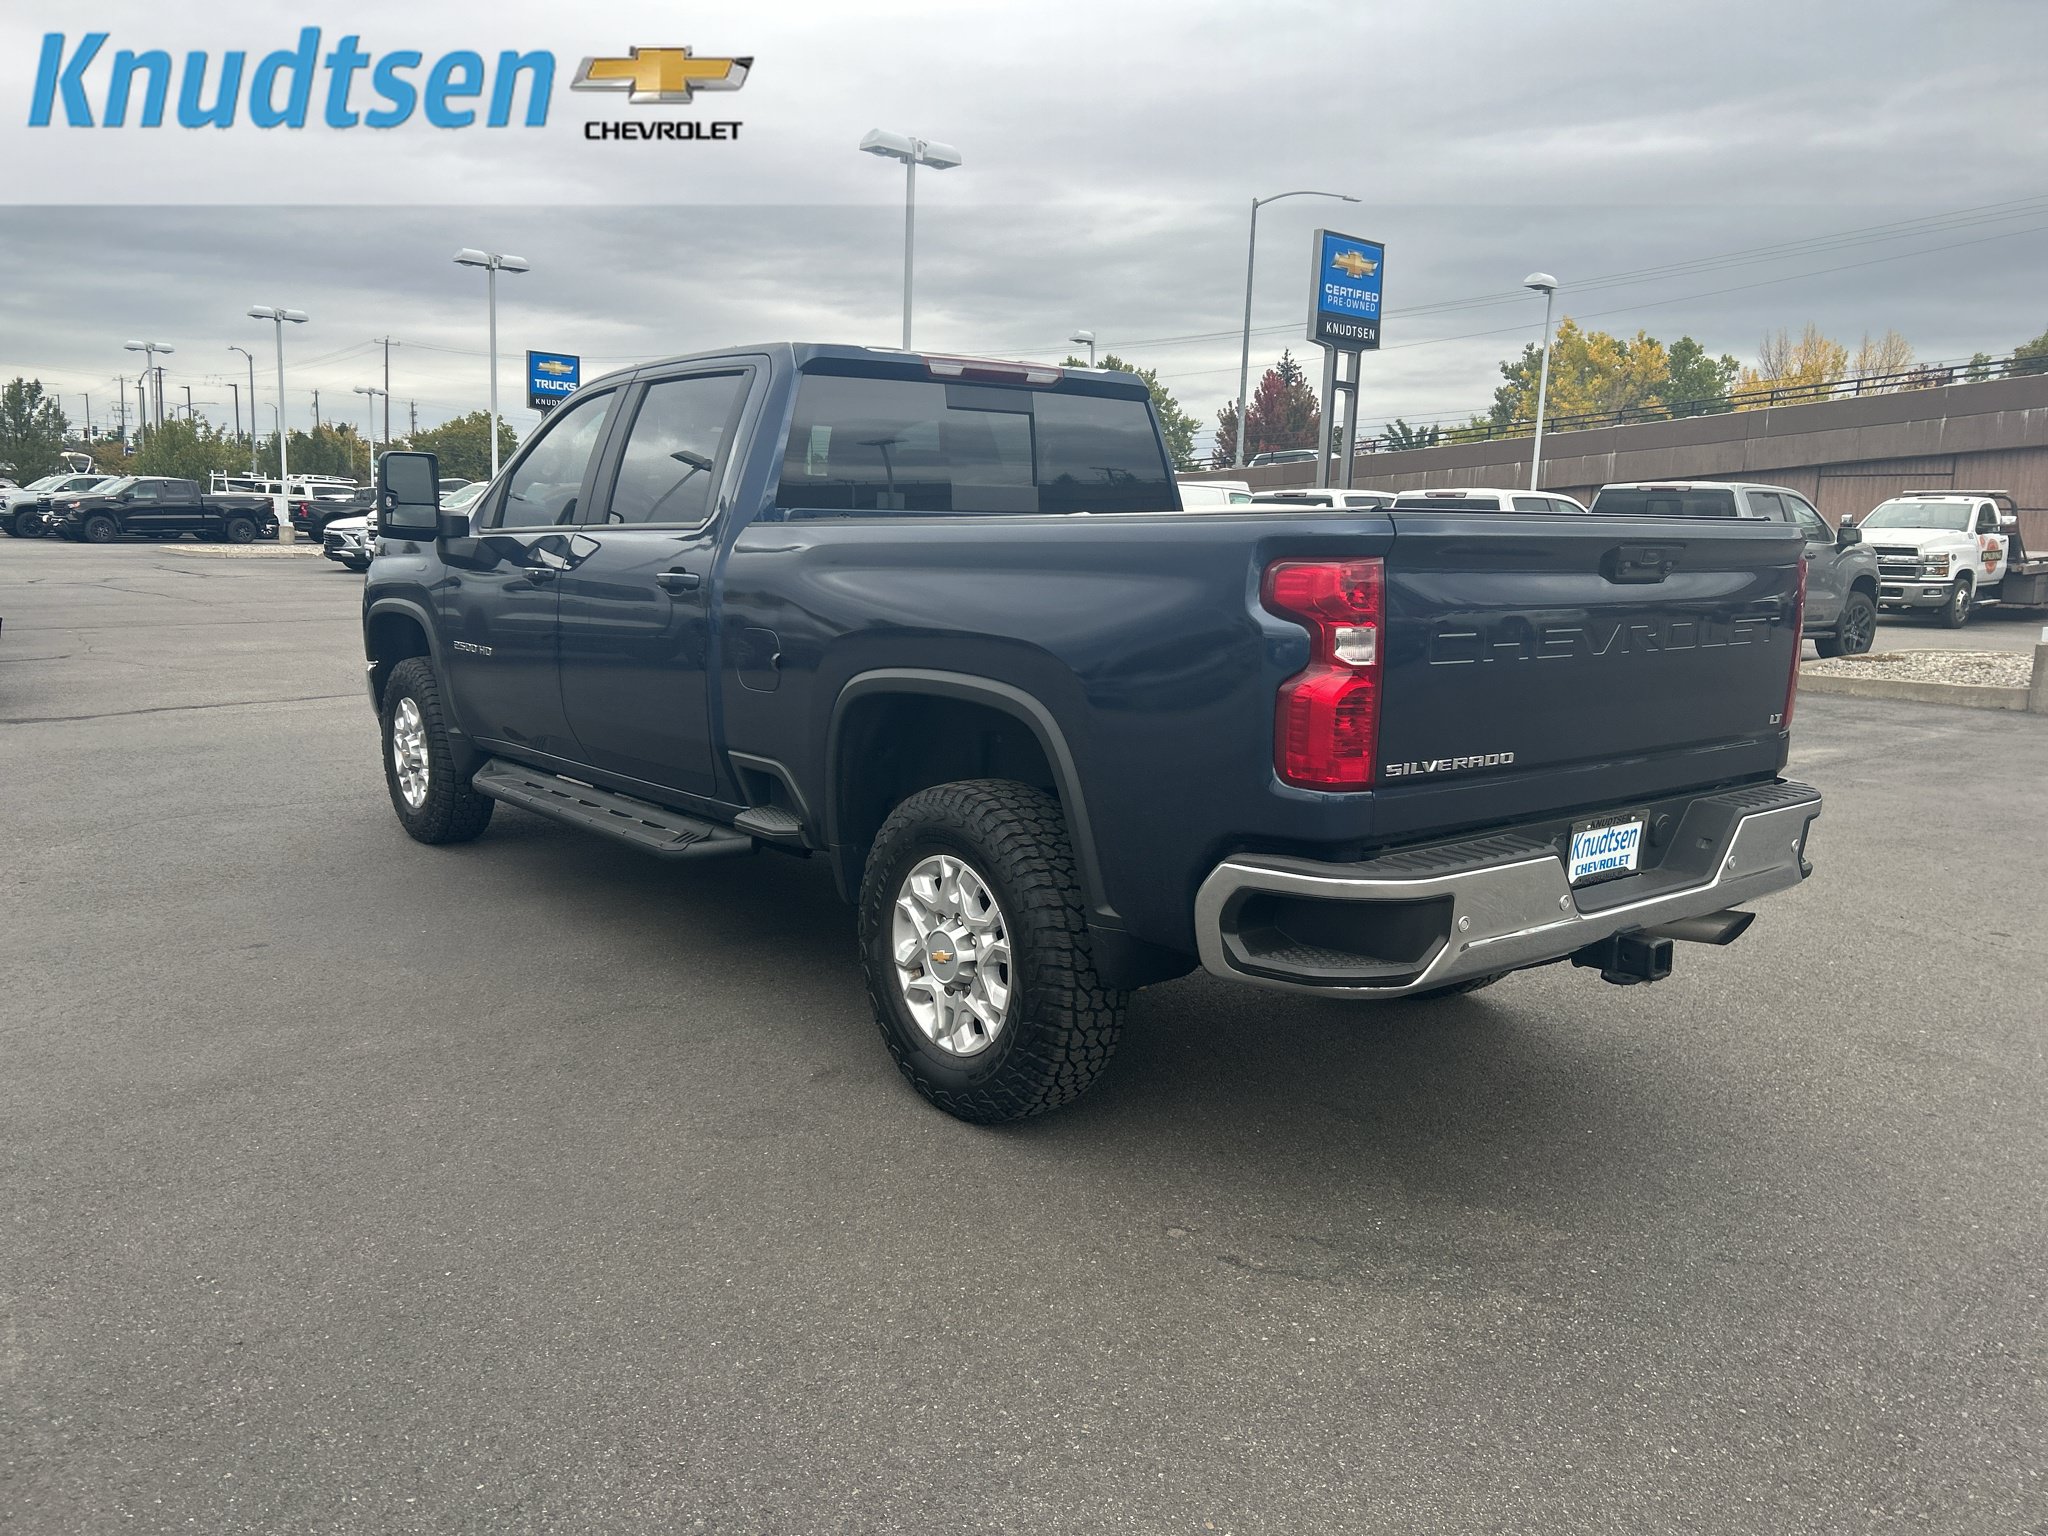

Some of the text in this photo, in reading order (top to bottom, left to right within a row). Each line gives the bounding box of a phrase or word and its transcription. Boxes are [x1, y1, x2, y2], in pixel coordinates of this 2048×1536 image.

[1325, 283, 1379, 302] CERTIFIED
[1327, 295, 1376, 312] PRE-OWNED
[1326, 321, 1375, 340] KNUDTSEN
[534, 378, 577, 392] TRUCKS
[1429, 614, 1780, 665] CHEVROLET
[479, 645, 492, 656] HD
[1769, 713, 1783, 725] LT
[1385, 751, 1515, 777] SILVERADO
[1571, 827, 1638, 861] Knudtsen
[1575, 854, 1630, 876] CHEVROLET
